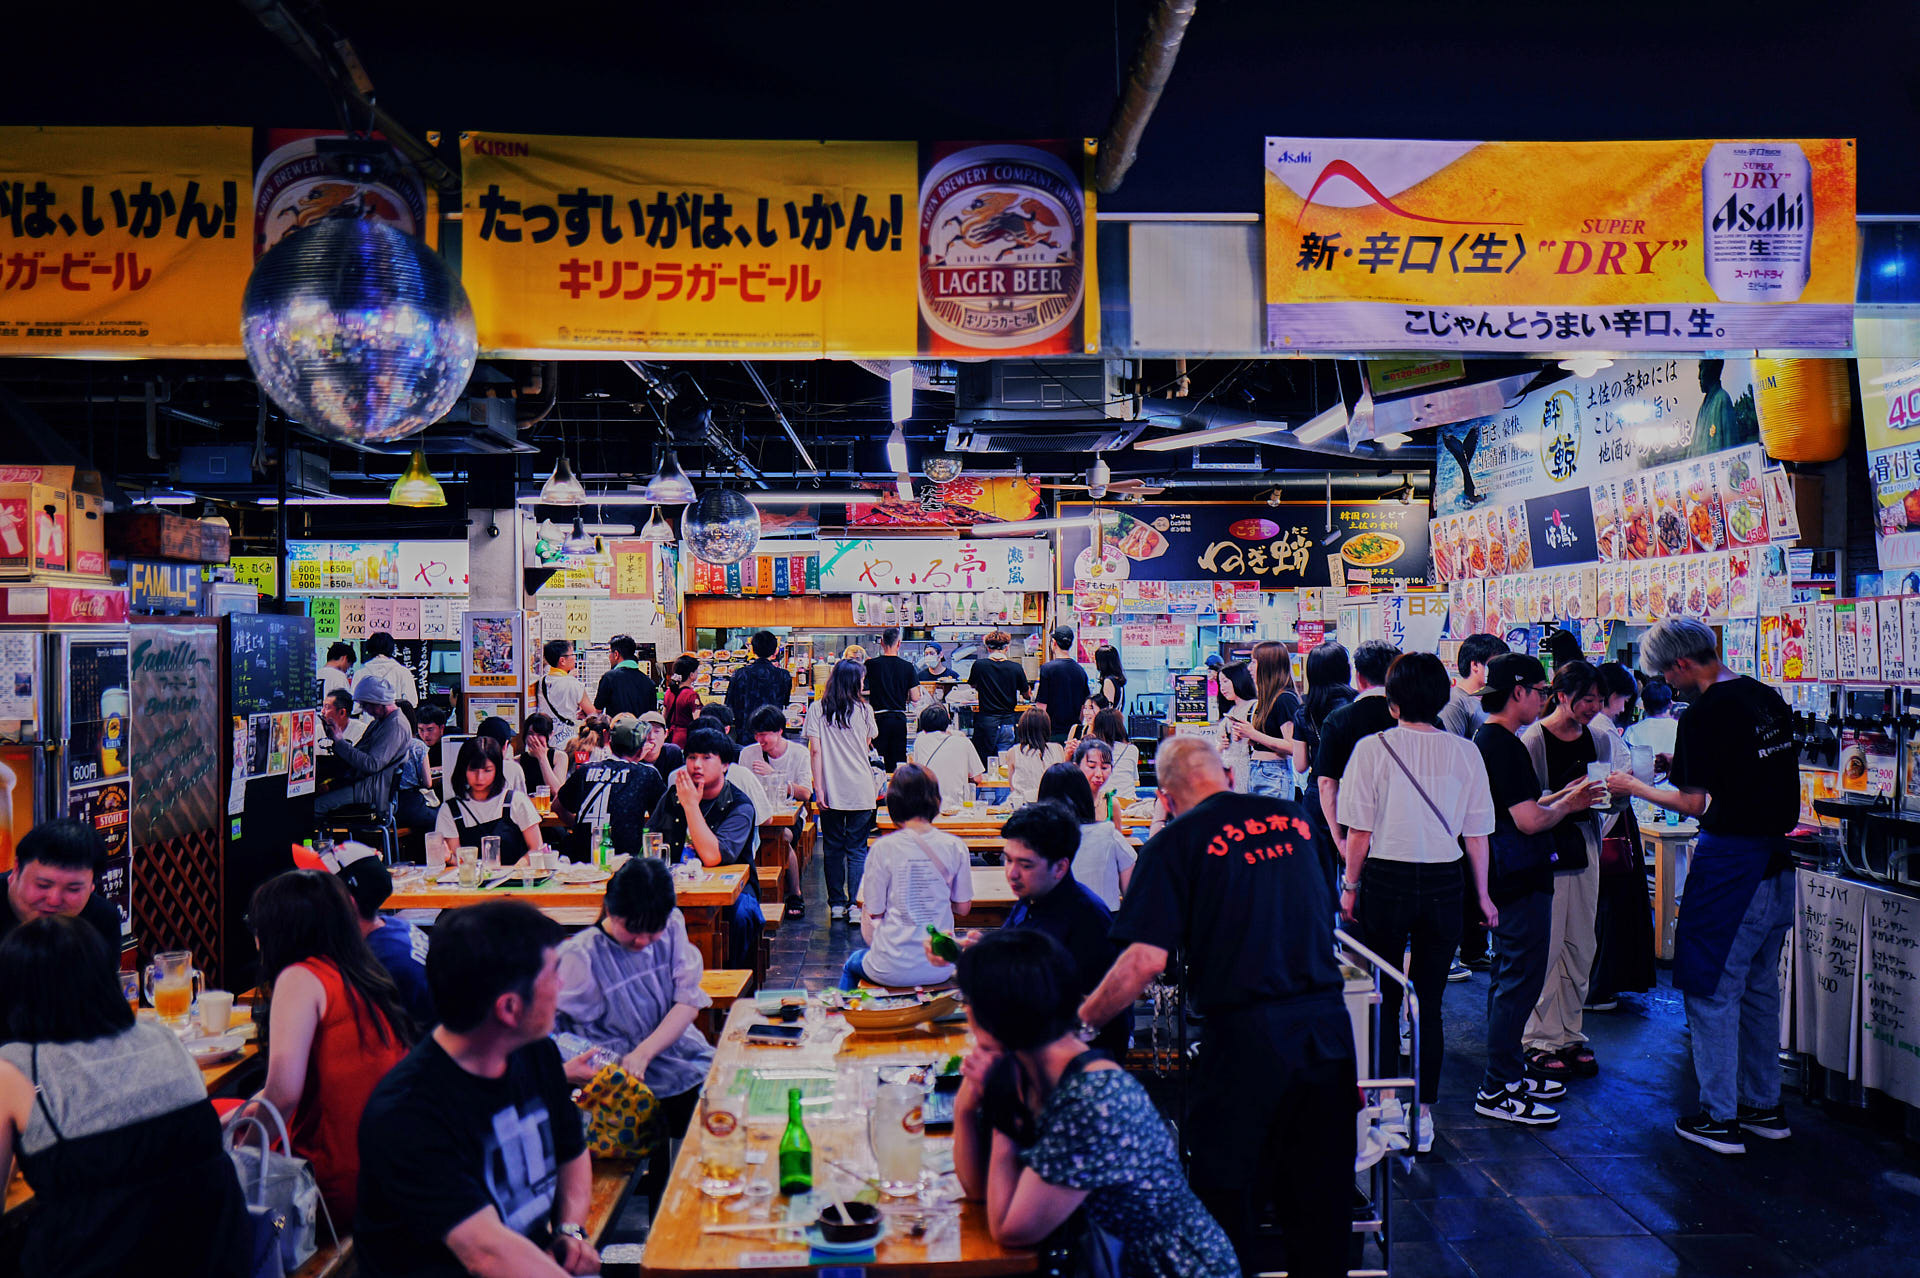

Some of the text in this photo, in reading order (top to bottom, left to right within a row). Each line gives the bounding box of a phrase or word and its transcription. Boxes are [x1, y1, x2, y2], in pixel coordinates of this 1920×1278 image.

[474, 140, 529, 157] KIRIN
[1278, 150, 1312, 164] Asahi
[1742, 162, 1774, 170] SUPER
[938, 167, 990, 198] BREWERY
[1712, 192, 1804, 232] Asahi
[1580, 218, 1646, 235] SUPER
[1750, 239, 1772, 256] 生
[1016, 253, 1046, 262] BEER
[0, 252, 152, 291] ガービール
[558, 257, 822, 302] キリンラガービール
[939, 268, 1063, 294] LAGER BEER
[1734, 269, 1784, 279] スーパードライ
[1403, 307, 1727, 340] こじゃんとうまい辛口、生。
[1586, 360, 1679, 410] 土佐の高知には
[1594, 396, 1679, 435] こじゃ旨い
[1543, 397, 1578, 479] 酔鯨
[1740, 477, 1758, 495] 300
[1236, 526, 1273, 536] こすも
[1291, 526, 1309, 535] たこ
[1746, 526, 1765, 545] 450
[858, 543, 987, 590] やいろ亭
[132, 563, 197, 607] FAMILLE
[577, 753, 587, 761] W
[73, 763, 97, 780] 600円
[100, 812, 123, 827] STOUT
[1244, 843, 1295, 865] STAFF
[103, 879, 124, 893] スタウト
[1807, 878, 1849, 905] チューハイ
[1881, 898, 1909, 917] サワー
